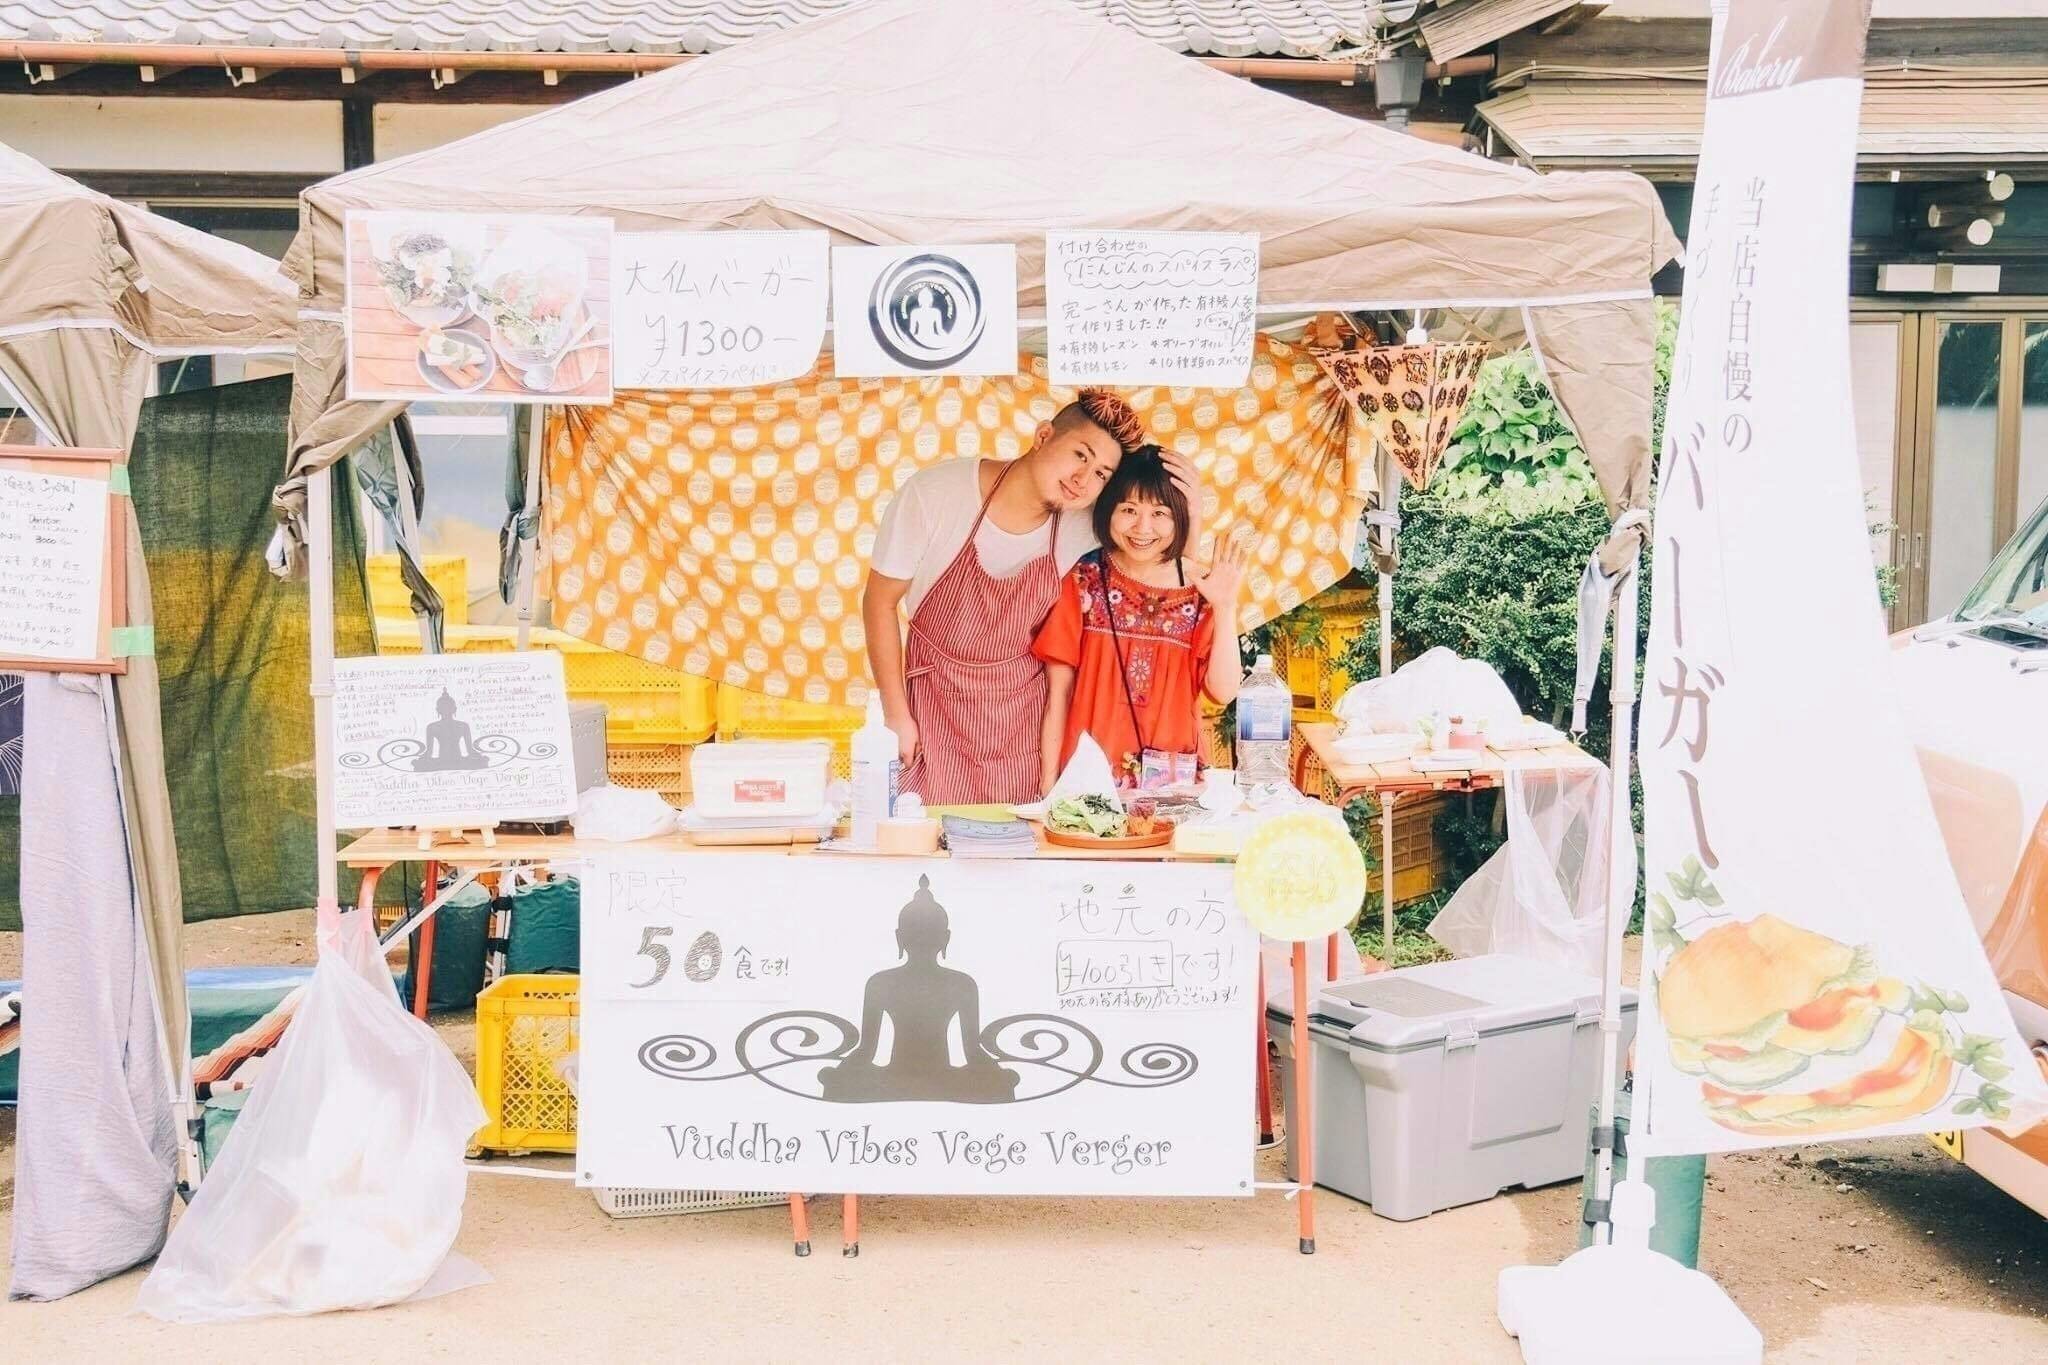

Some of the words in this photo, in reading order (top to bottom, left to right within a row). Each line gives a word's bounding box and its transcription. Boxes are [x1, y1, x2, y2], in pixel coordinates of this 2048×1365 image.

[1715, 15, 1803, 97] Bakery
[1058, 237, 1149, 255] 付け合わせの
[1078, 256, 1251, 278] にんじんのスパイスラペ
[625, 255, 814, 298] 大仏バーガー
[1722, 175, 1765, 453] 当店自慢の
[1658, 421, 1726, 870] バーガー
[608, 868, 694, 918] 限定
[1058, 889, 1227, 936] 地元の方
[661, 1121, 803, 1164] Vuddha
[816, 1124, 919, 1166] Vibes
[932, 1129, 1028, 1175] Vege
[1041, 1130, 1173, 1176] Verger
